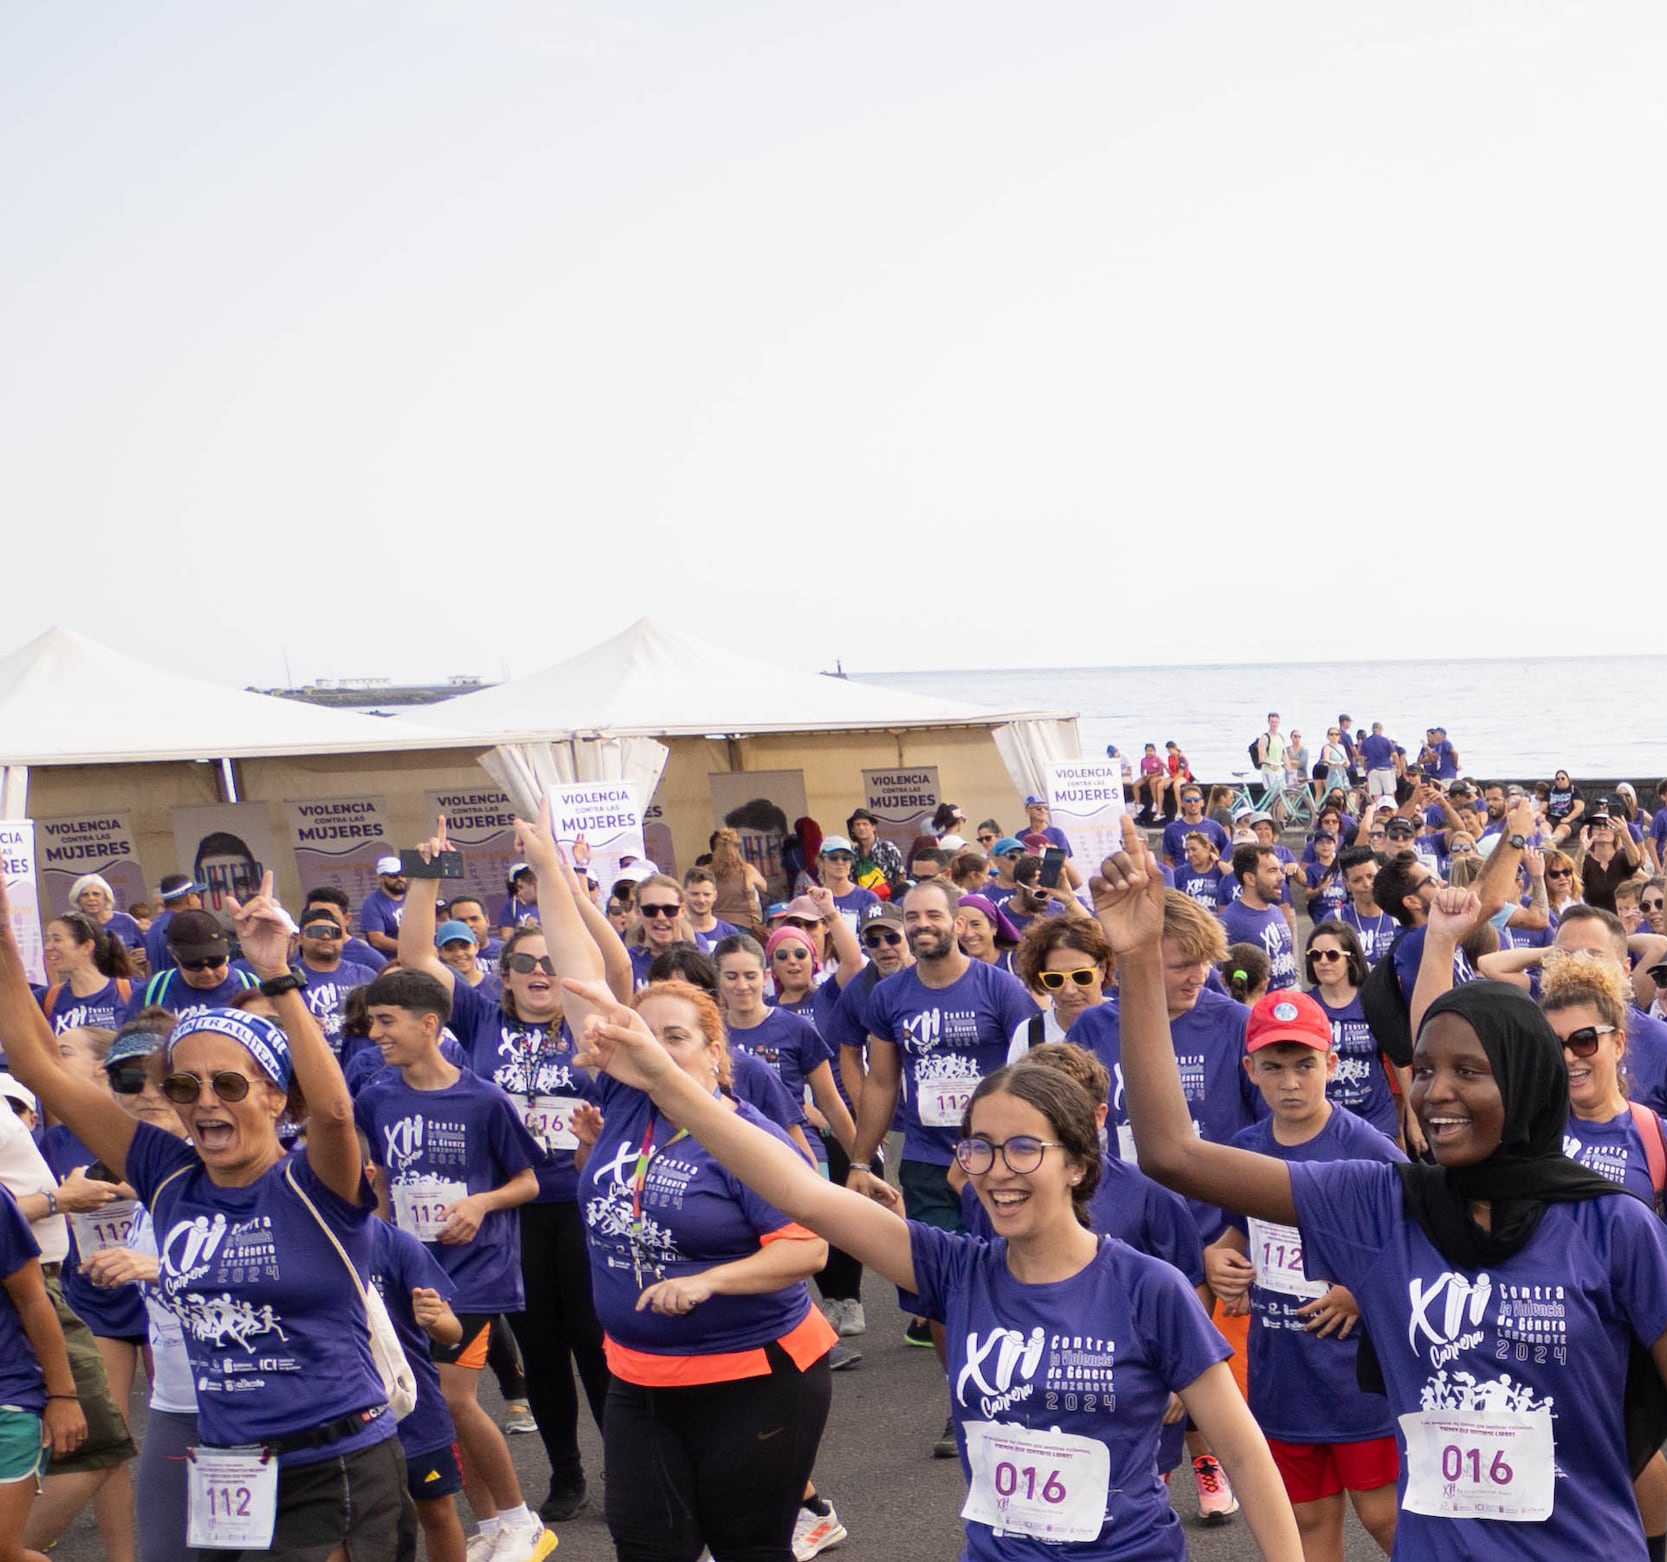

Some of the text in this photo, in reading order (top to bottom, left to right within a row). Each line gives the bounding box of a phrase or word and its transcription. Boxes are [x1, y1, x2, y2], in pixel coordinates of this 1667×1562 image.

[872, 775, 930, 786] VIOLENCIA
[1056, 768, 1112, 778] VIOLENCIA
[438, 793, 510, 807] VIOLENCIA
[561, 790, 629, 804] VIOLENCIA
[870, 795, 936, 808] MUJERES
[1055, 788, 1119, 802] MUJERES
[299, 803, 376, 816] VIOLENCIA
[45, 820, 121, 835] VIOLENCIA
[437, 813, 516, 830] MUJERES
[562, 813, 636, 832] MUJERES
[298, 824, 384, 840] MUJERES
[46, 841, 130, 861] MUJERES
[200, 1016, 250, 1047] TRAIL
[427, 1120, 467, 1131] Contra
[410, 1203, 448, 1224] 112
[1264, 1242, 1302, 1271] 112
[218, 1264, 280, 1284] 2024
[1500, 1283, 1564, 1299] Contra
[1498, 1315, 1566, 1331] de Género
[1052, 1335, 1116, 1352] Contra
[1497, 1328, 1567, 1345] LANZAROTE
[1430, 1331, 1484, 1369] Carrera
[1496, 1340, 1567, 1366] 2024
[1048, 1365, 1114, 1381] de Género
[1047, 1381, 1115, 1392] LANZAROTE
[1046, 1393, 1116, 1412] 2024
[1442, 1445, 1513, 1485] 016
[994, 1462, 1067, 1504] 016
[206, 1486, 252, 1517] 112
